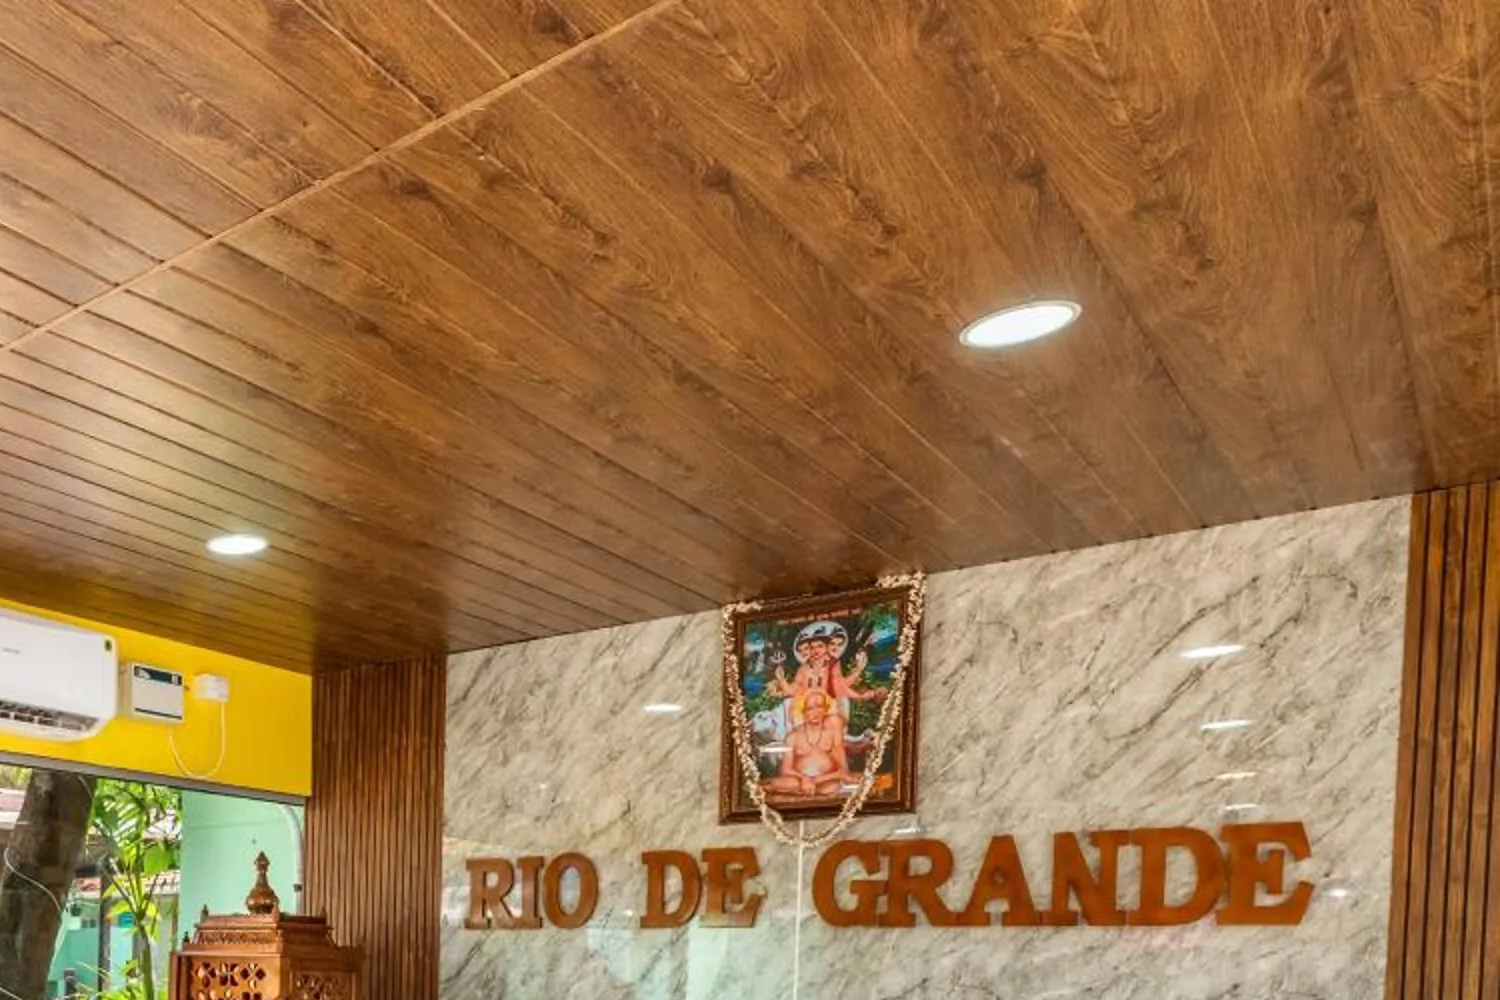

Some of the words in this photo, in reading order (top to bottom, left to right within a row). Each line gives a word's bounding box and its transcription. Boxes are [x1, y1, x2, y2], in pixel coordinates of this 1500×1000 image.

[464, 852, 599, 929] RIO
[640, 846, 768, 928] DE
[812, 821, 1315, 928] GRANDE
